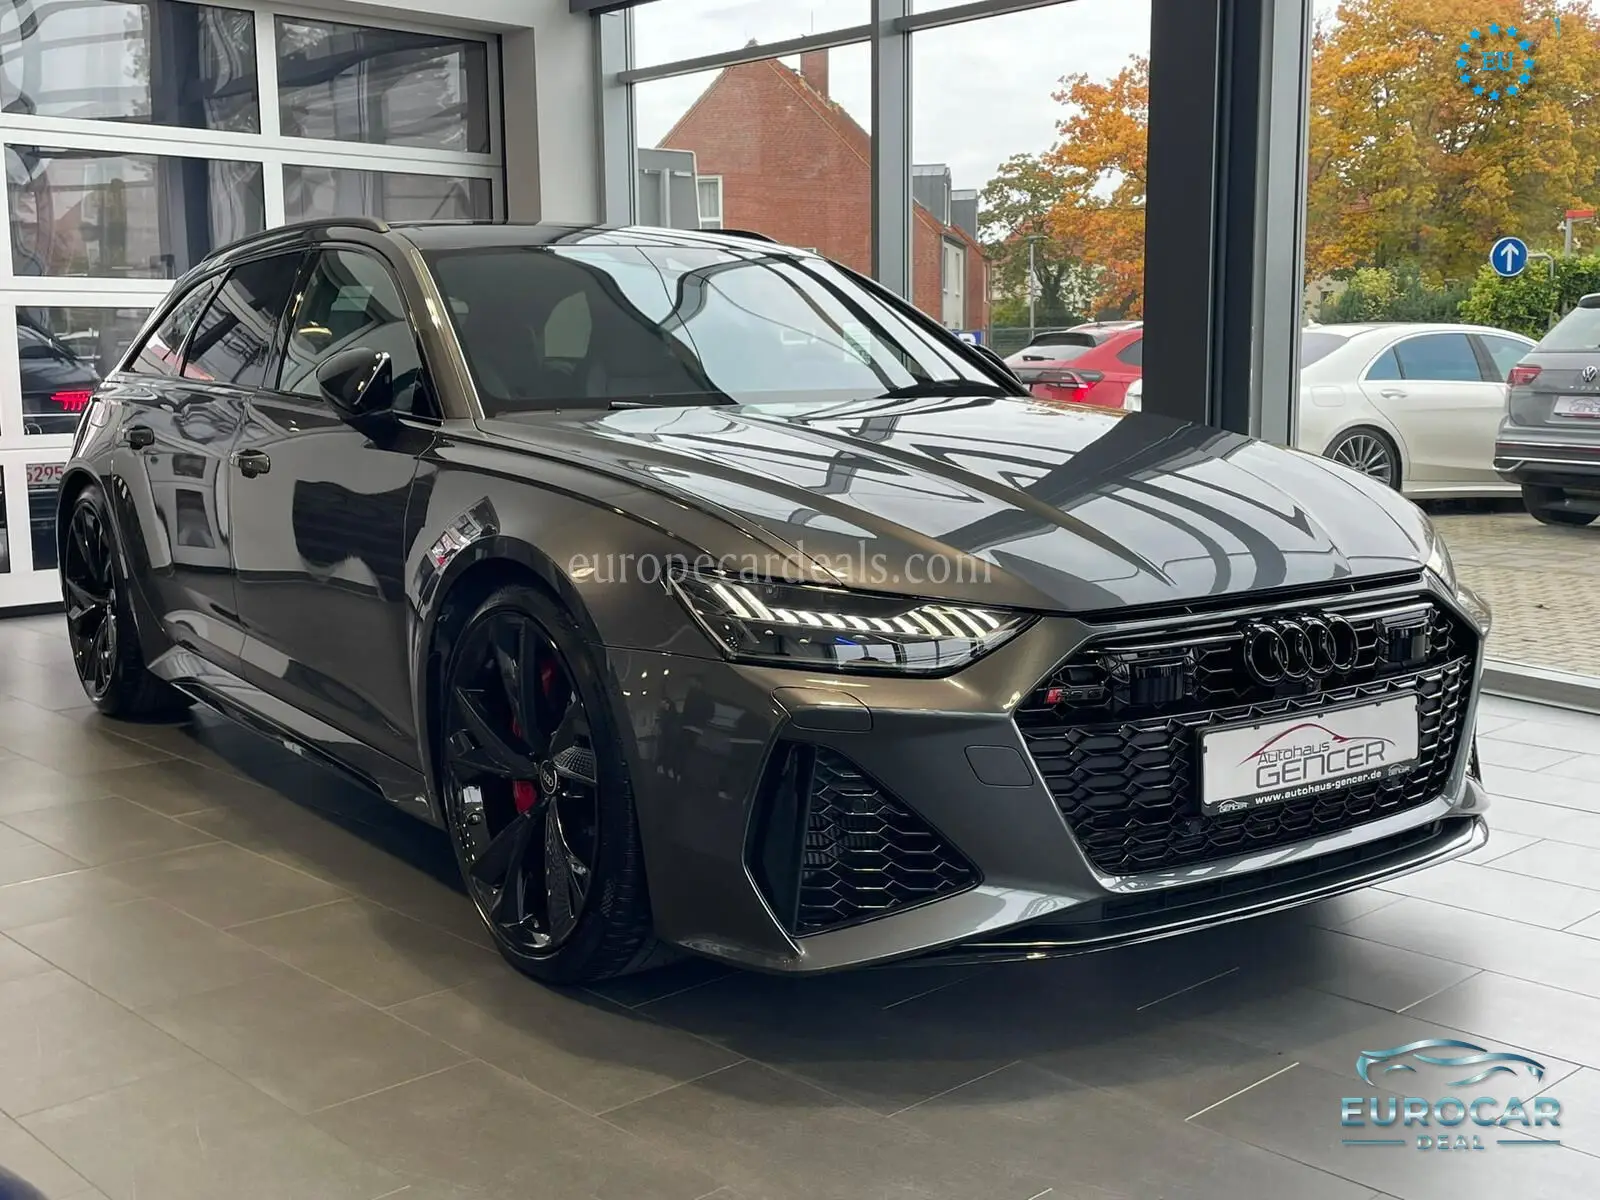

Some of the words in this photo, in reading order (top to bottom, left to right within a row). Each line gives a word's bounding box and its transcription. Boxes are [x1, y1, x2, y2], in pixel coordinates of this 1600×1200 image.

[1256, 740, 1385, 789] GENCER
[1257, 741, 1330, 766] Autohaus
[1255, 769, 1382, 805] www.autohaus-gencer.de
